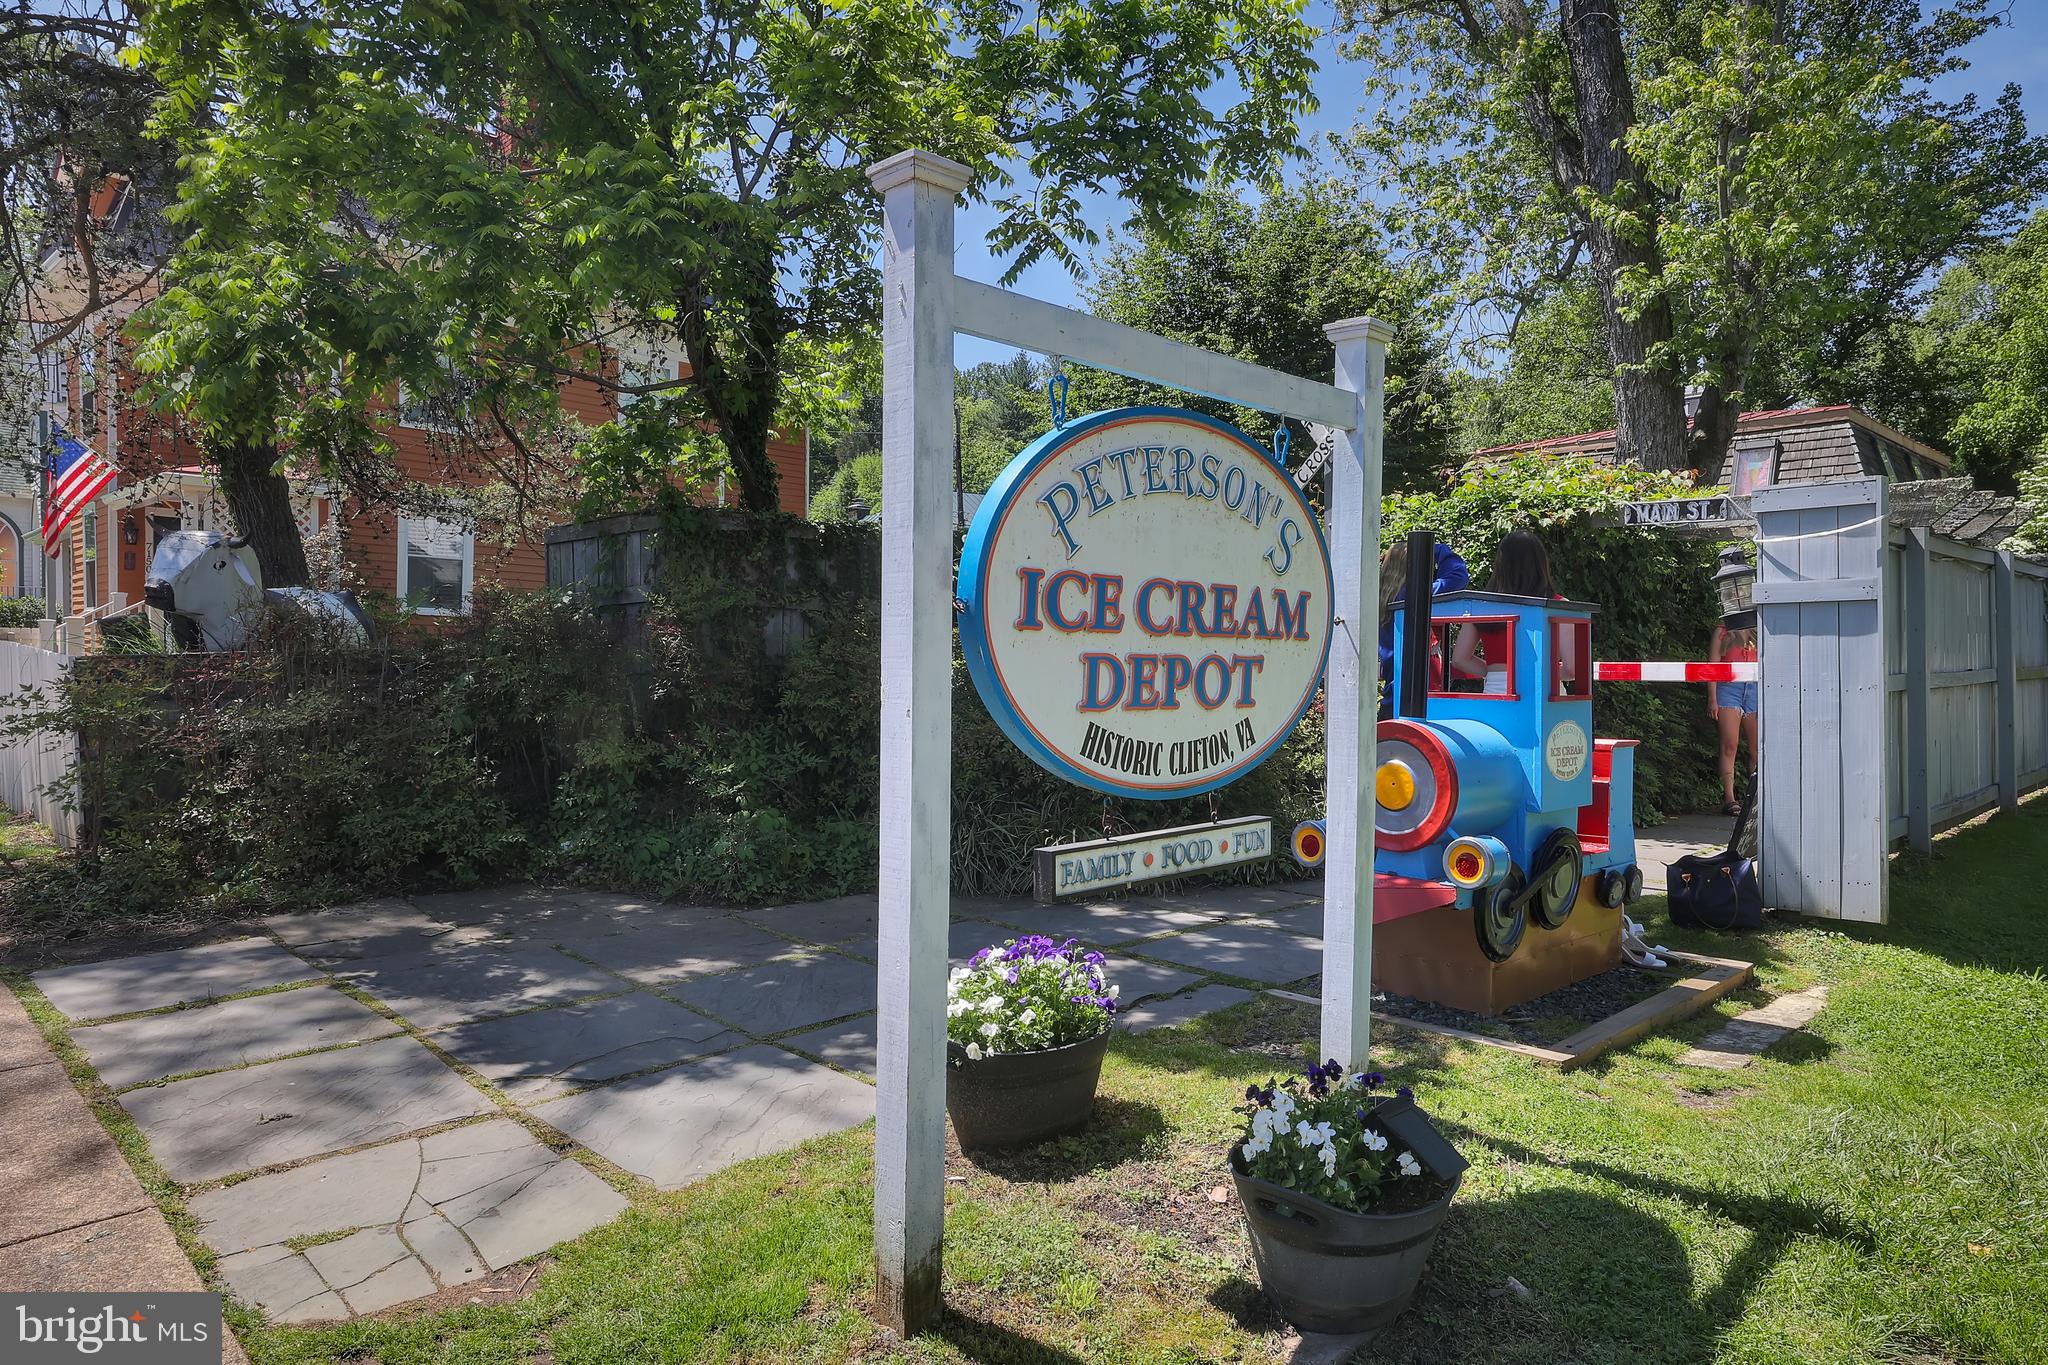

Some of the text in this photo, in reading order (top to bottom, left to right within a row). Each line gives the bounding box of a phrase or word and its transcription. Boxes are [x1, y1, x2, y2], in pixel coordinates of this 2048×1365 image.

[1038, 446, 1303, 575] PETERSON'S
[1637, 500, 1716, 522] MAIN ST.
[1016, 568, 1311, 641] ICE CREAM
[1077, 652, 1265, 713] DEPOT
[1080, 716, 1256, 776] HISTORIC CLIFTON, VA
[1551, 745, 1584, 757] ICE CREAM
[1556, 757, 1578, 768] DEPOT
[1060, 828, 1266, 886] FAMILY FOOD FUN
